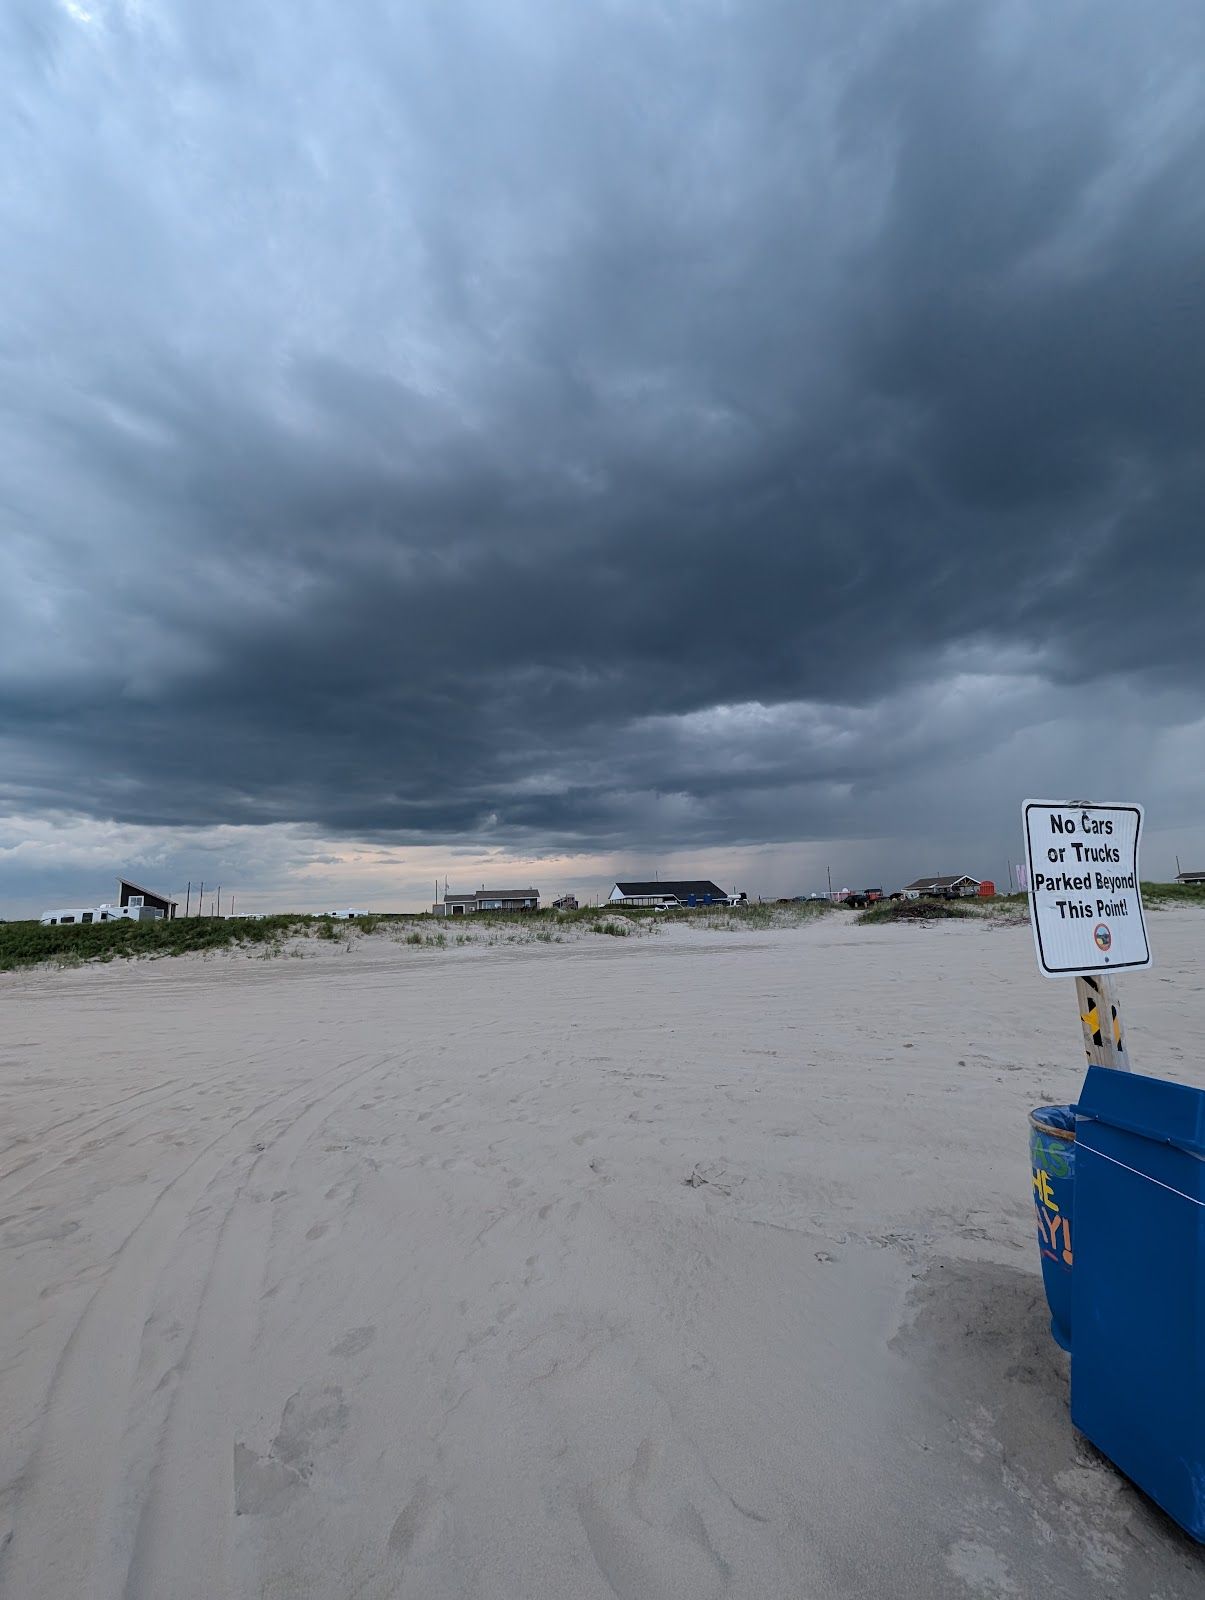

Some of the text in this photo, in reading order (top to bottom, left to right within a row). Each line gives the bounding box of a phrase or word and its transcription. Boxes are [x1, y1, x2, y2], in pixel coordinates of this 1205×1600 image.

[1050, 813, 1113, 835] No Cars
[1047, 842, 1120, 863] or Trucks
[1035, 872, 1135, 893] Parked Beyond
[1056, 899, 1129, 919] This Point!
